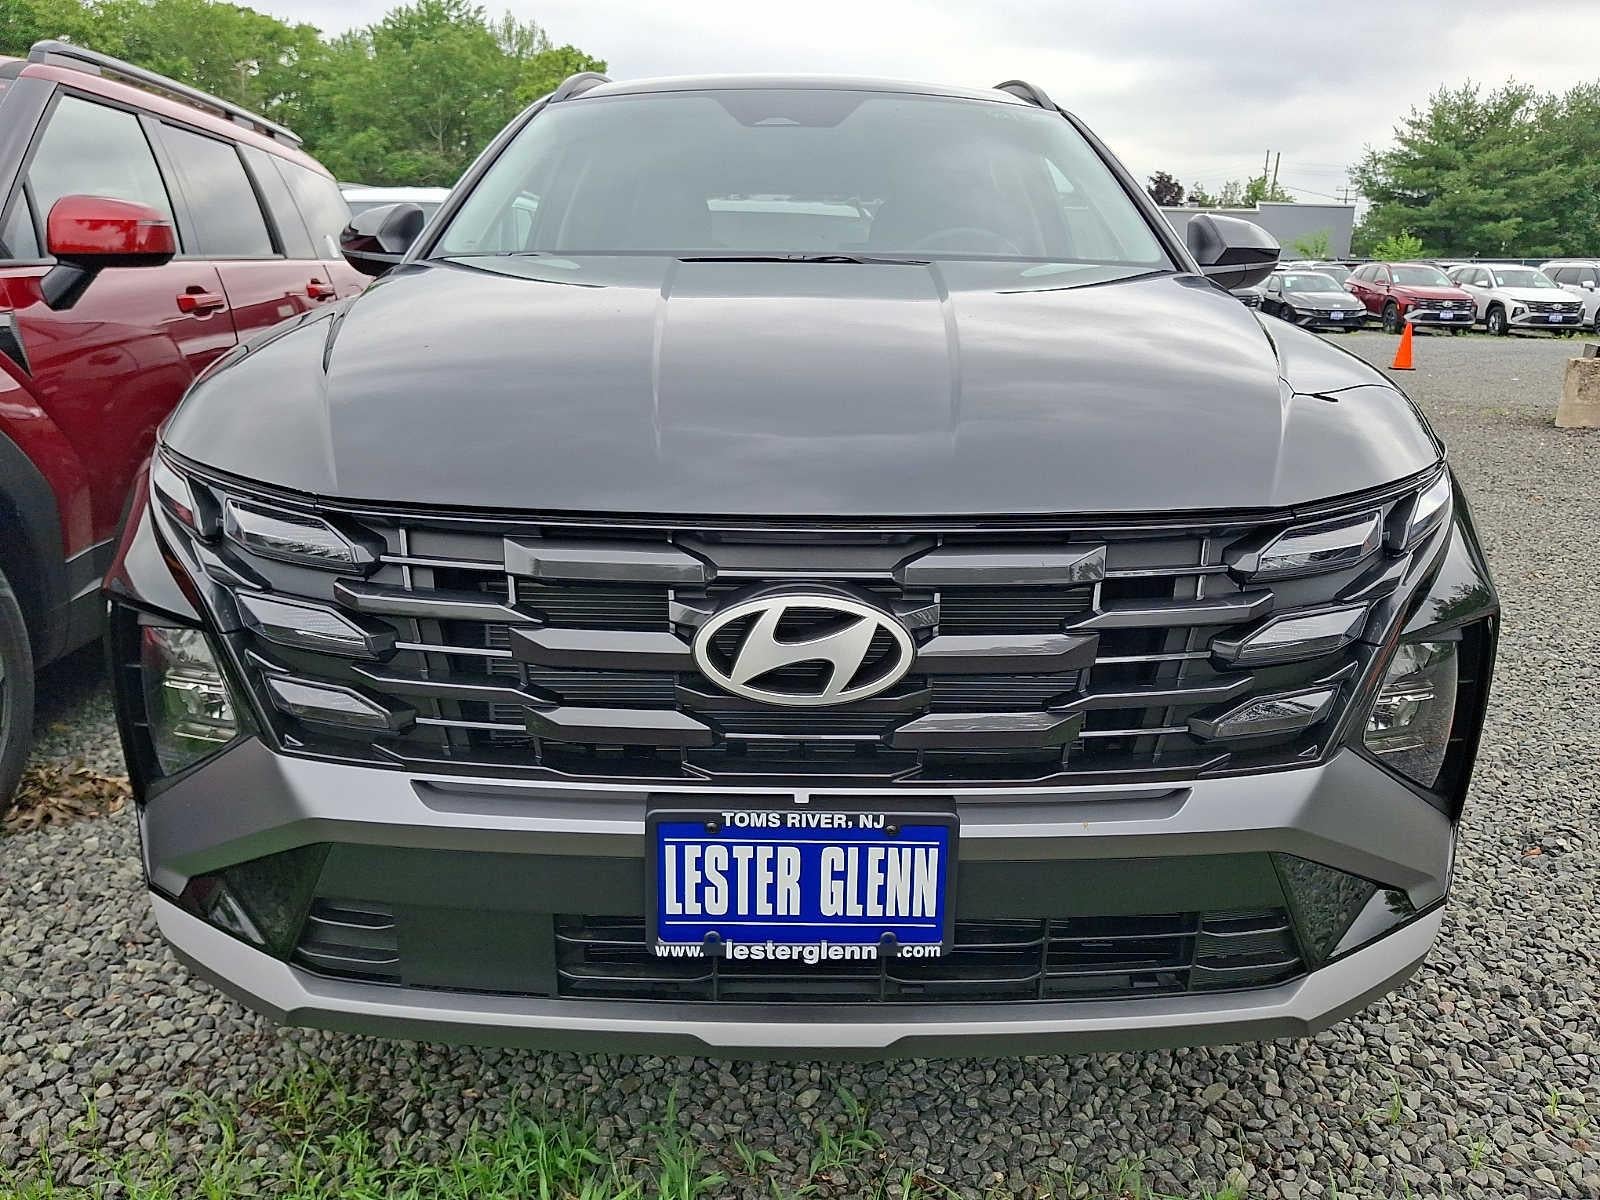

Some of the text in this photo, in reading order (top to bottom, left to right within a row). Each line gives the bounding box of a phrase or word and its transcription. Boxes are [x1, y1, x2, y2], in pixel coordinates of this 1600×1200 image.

[722, 812, 885, 829] TOMS RIVER, NJ
[664, 845, 939, 918] LESTER GLENN
[655, 939, 941, 964] www. lesterglenn .com
